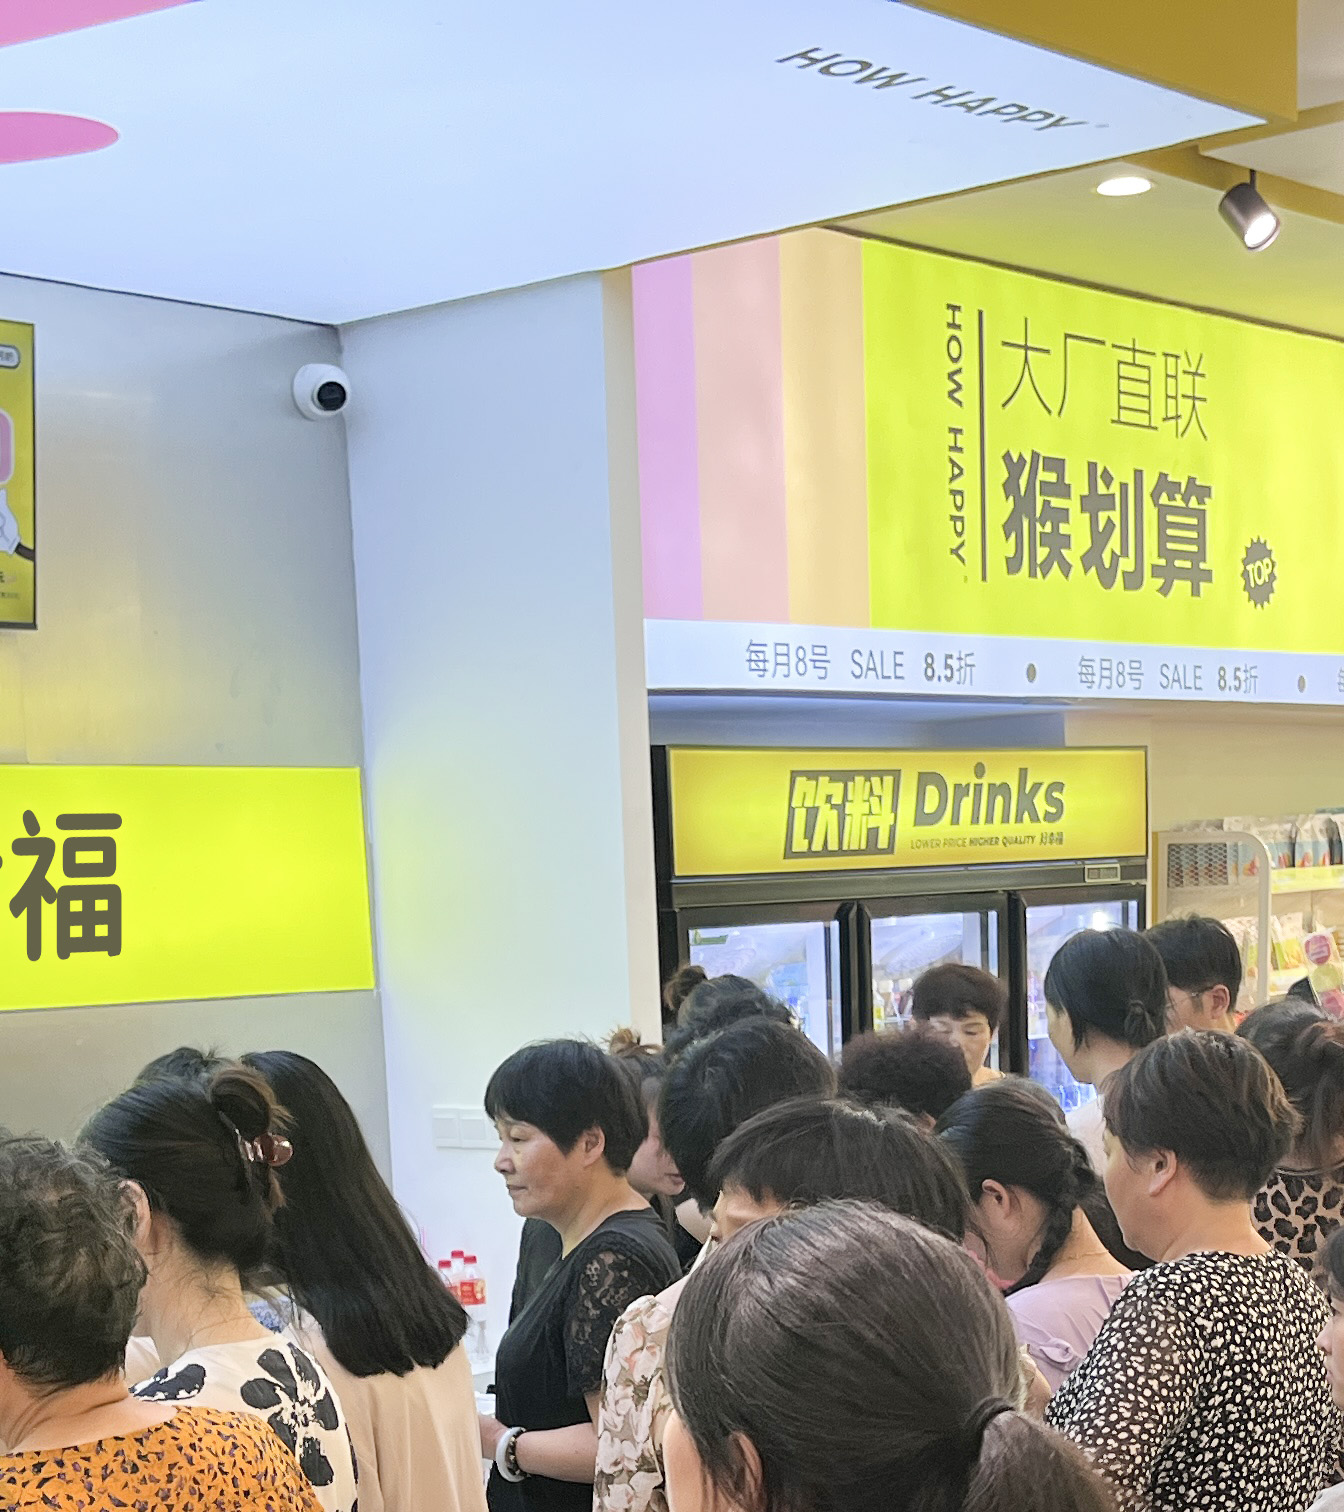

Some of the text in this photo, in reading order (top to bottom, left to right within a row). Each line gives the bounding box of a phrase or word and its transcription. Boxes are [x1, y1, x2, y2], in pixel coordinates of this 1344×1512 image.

[775, 46, 1088, 131] HOW HAPPY
[1001, 317, 1208, 441] 大厂直联
[946, 302, 966, 566] HOW HAPPY
[1001, 448, 1213, 599] 猴划算
[1245, 557, 1273, 588] TOP
[745, 638, 976, 687] 每月8号 SALE 8.5折
[1077, 655, 1259, 695] 每月8号 SALE 8.5折
[789, 761, 1066, 854] 饮料 Drinks
[910, 839, 942, 850] LOWER
[943, 837, 967, 848] PRICE
[969, 836, 1000, 847] HIGHER
[1002, 834, 1036, 847] QUALITY
